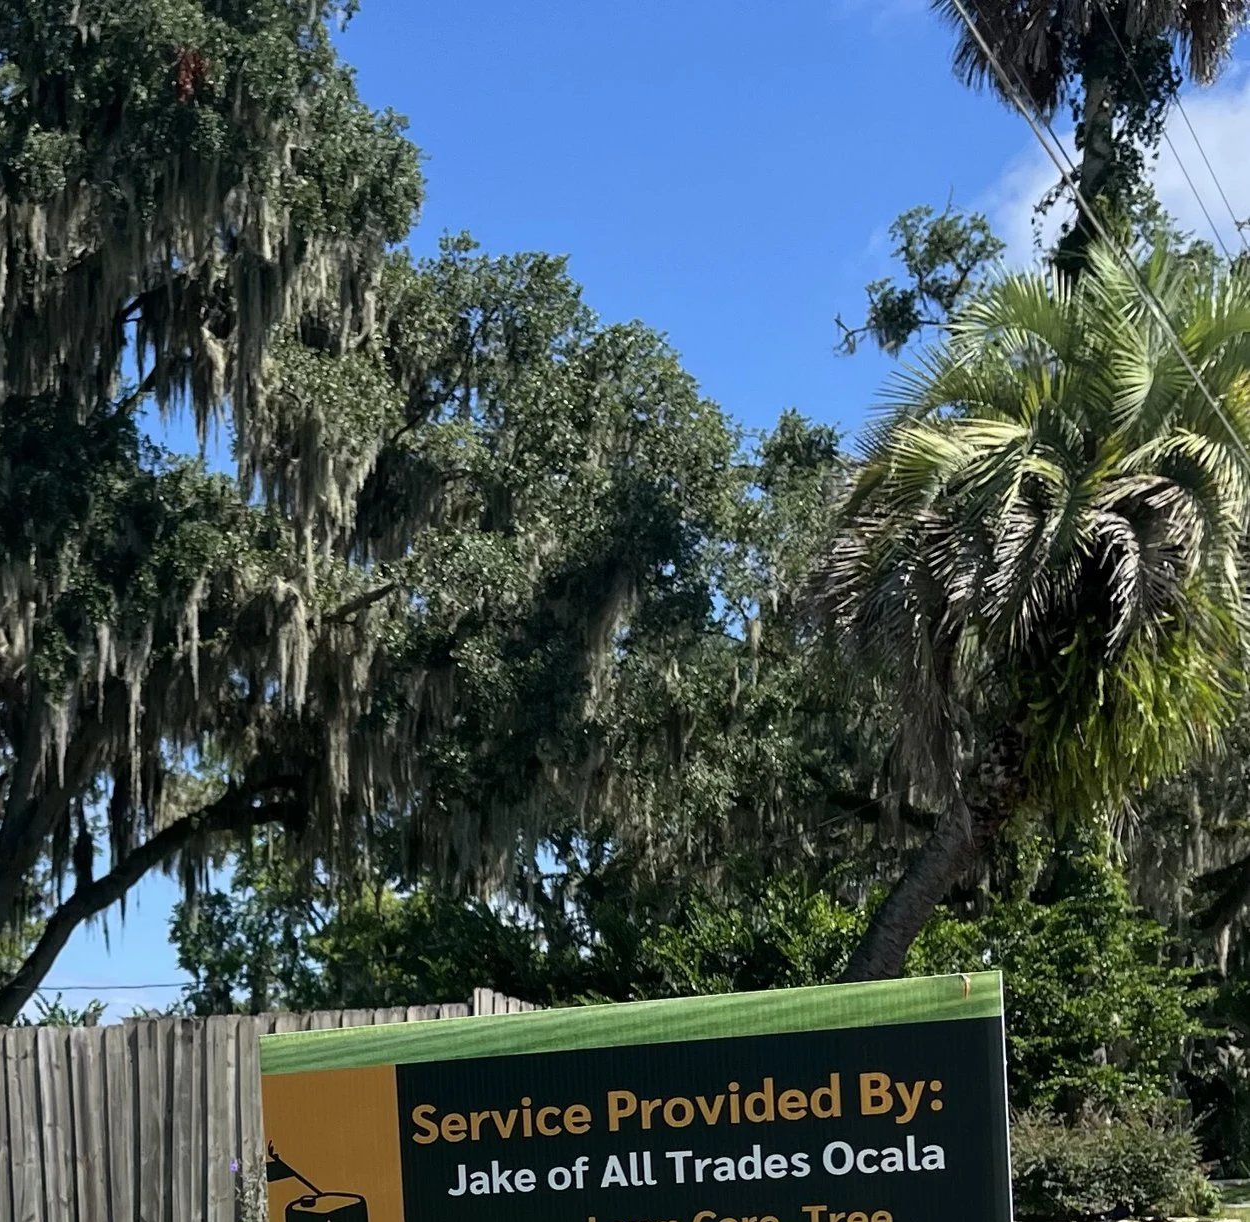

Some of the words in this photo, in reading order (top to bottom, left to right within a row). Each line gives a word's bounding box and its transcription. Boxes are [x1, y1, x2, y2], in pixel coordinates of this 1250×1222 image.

[412, 1097, 590, 1145] Service
[608, 1074, 841, 1132] Provided
[860, 1072, 944, 1124] By:
[448, 1161, 536, 1196] Jake
[548, 1155, 591, 1190] of
[601, 1152, 656, 1188] All
[666, 1145, 810, 1185] Trades
[823, 1136, 945, 1176] Ocala
